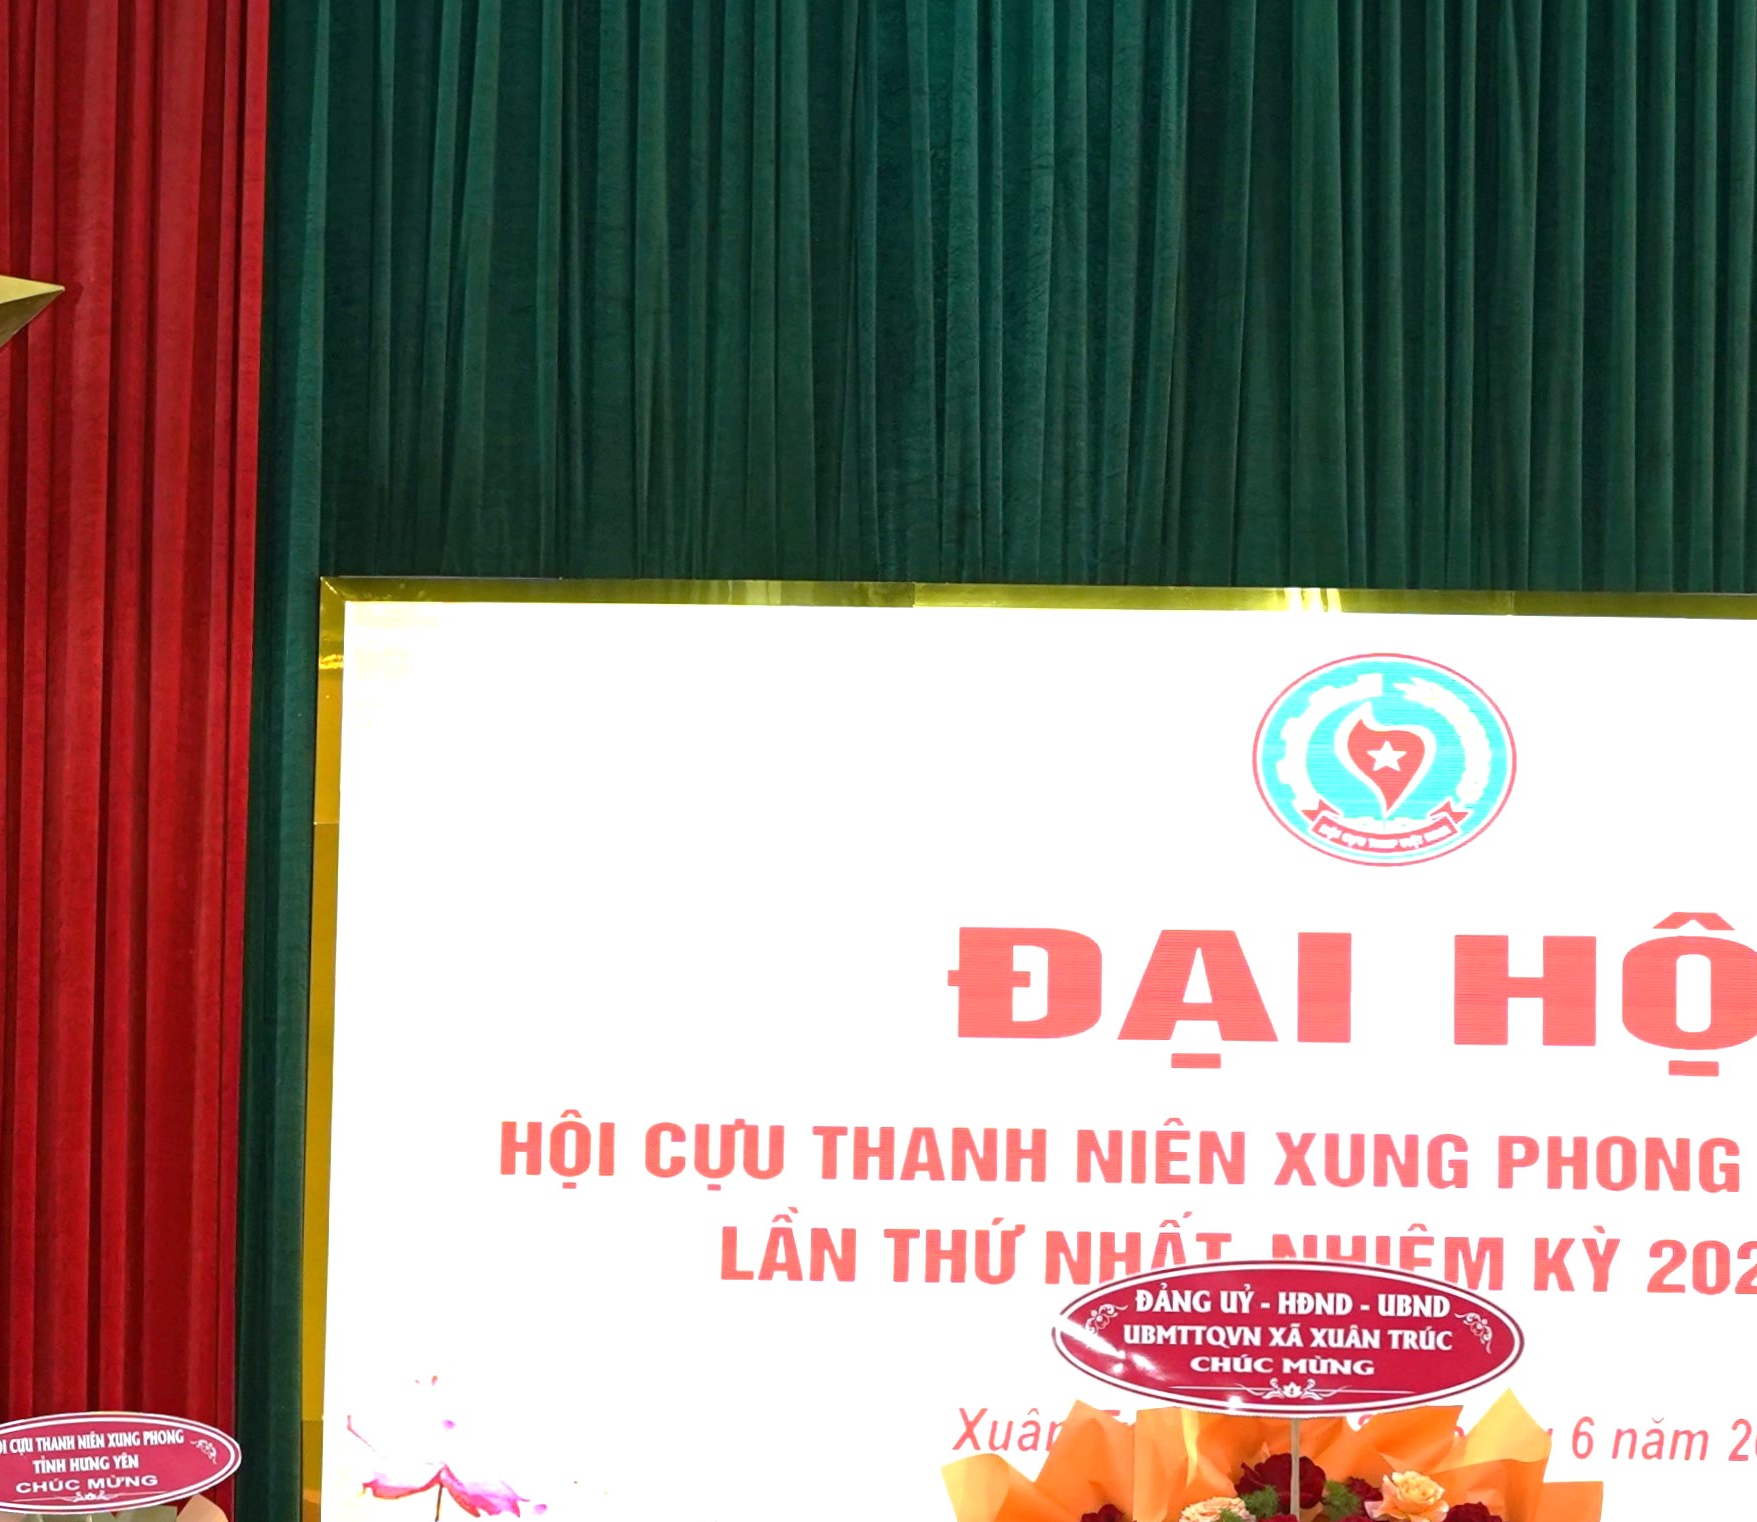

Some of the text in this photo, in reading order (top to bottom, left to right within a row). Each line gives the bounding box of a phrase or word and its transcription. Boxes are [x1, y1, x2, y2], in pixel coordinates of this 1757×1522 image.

[948, 927, 1351, 1068] ĐẠI
[501, 1110, 615, 1189] HỘI
[645, 1119, 784, 1191] CỰU
[813, 1126, 1046, 1182] THANH
[1077, 1118, 1245, 1185] NIÊN
[1275, 1132, 1468, 1189] XUNG
[1498, 1136, 1739, 1193] PHONG
[721, 1207, 856, 1282] LẦN
[884, 1218, 1025, 1284] THỨ
[1534, 1226, 1620, 1292] KỲ
[1135, 1282, 1211, 1313] ĐẢNG
[1220, 1283, 1255, 1313] UỶ
[1278, 1292, 1353, 1315] HĐND
[1377, 1294, 1450, 1317] UBND
[1124, 1323, 1453, 1350] UBMTTQVN XÃ XUÂN TRÚC
[1190, 1354, 1375, 1375] CHÚC MỪNG
[9, 1437, 33, 1456] CỰU
[36, 1435, 75, 1451] THANH
[77, 1431, 105, 1449] NIÊN
[107, 1432, 140, 1448] XUNG
[143, 1429, 184, 1445] PHONG
[1572, 1416, 1595, 1459] 6
[1612, 1417, 1709, 1461] năm
[33, 1452, 140, 1474] TỈNH HƯNG YÊN
[15, 1474, 158, 1493] CHÚC MỪNG
